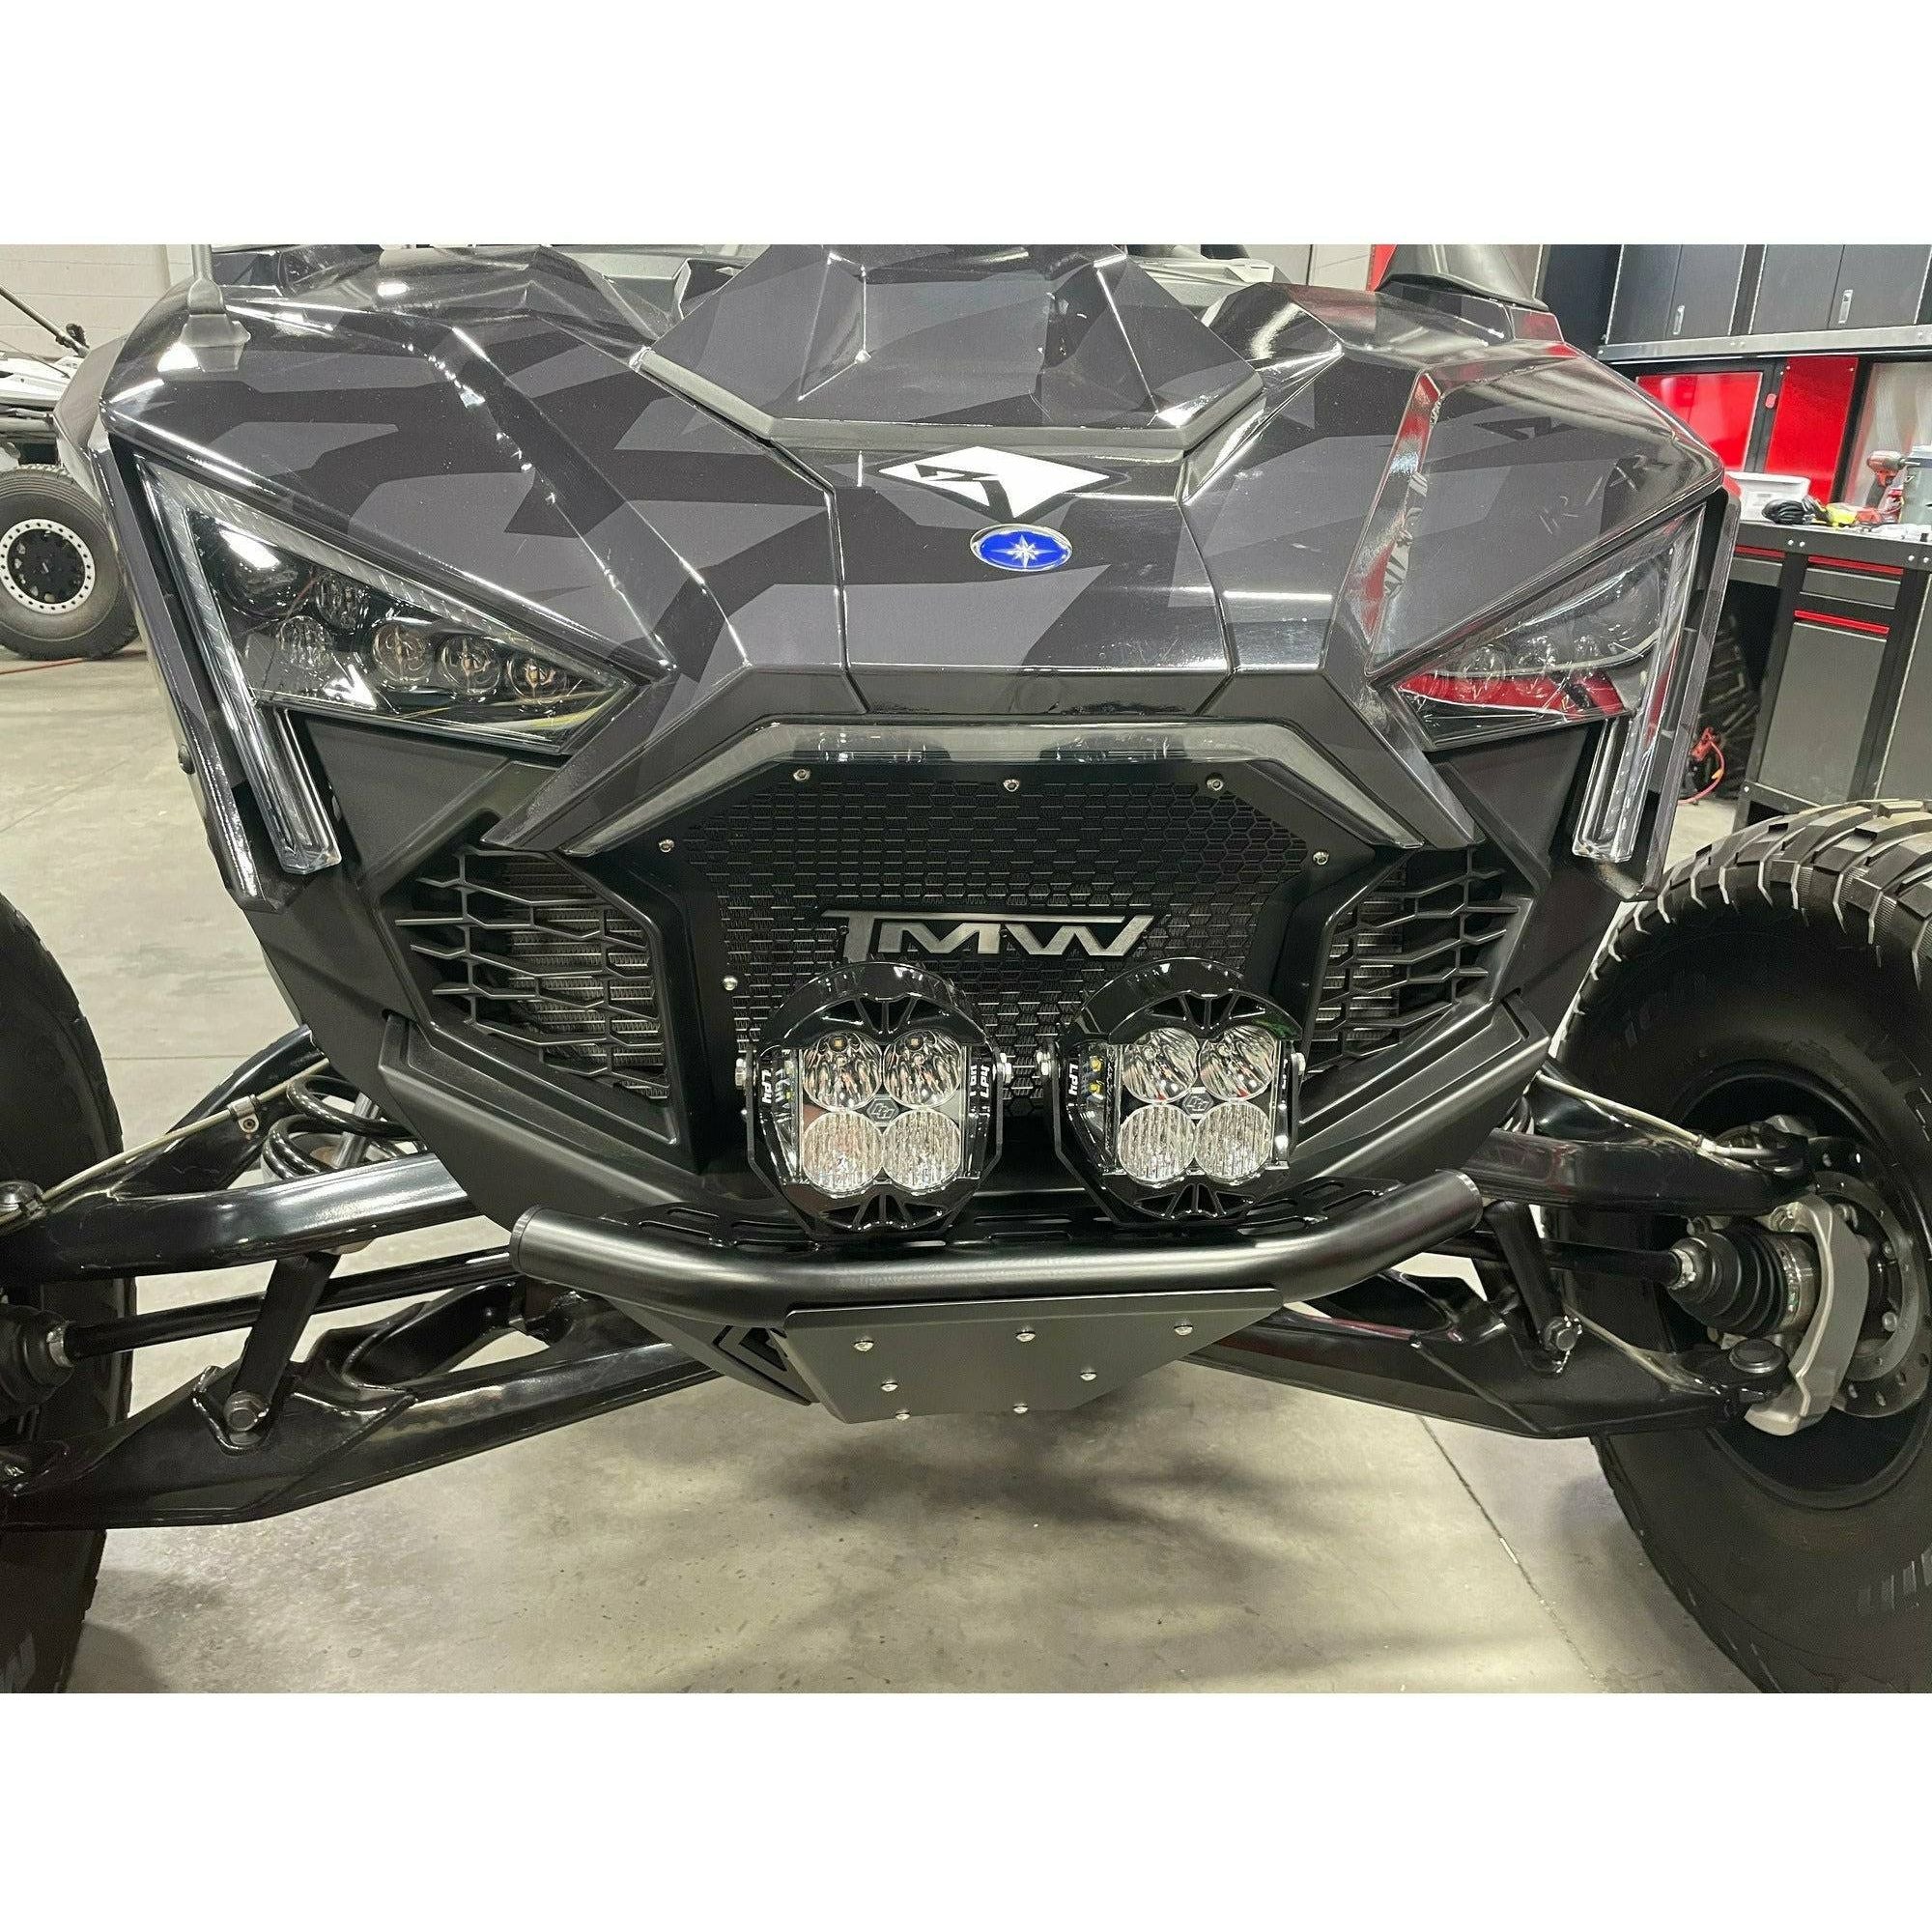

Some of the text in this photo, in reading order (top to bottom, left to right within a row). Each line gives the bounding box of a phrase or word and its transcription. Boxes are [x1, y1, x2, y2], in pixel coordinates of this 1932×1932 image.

[821, 910, 1154, 963] TMW
[761, 1069, 772, 1104] LP4
[980, 1064, 990, 1098] LP4
[1068, 1063, 1079, 1095] LP4
